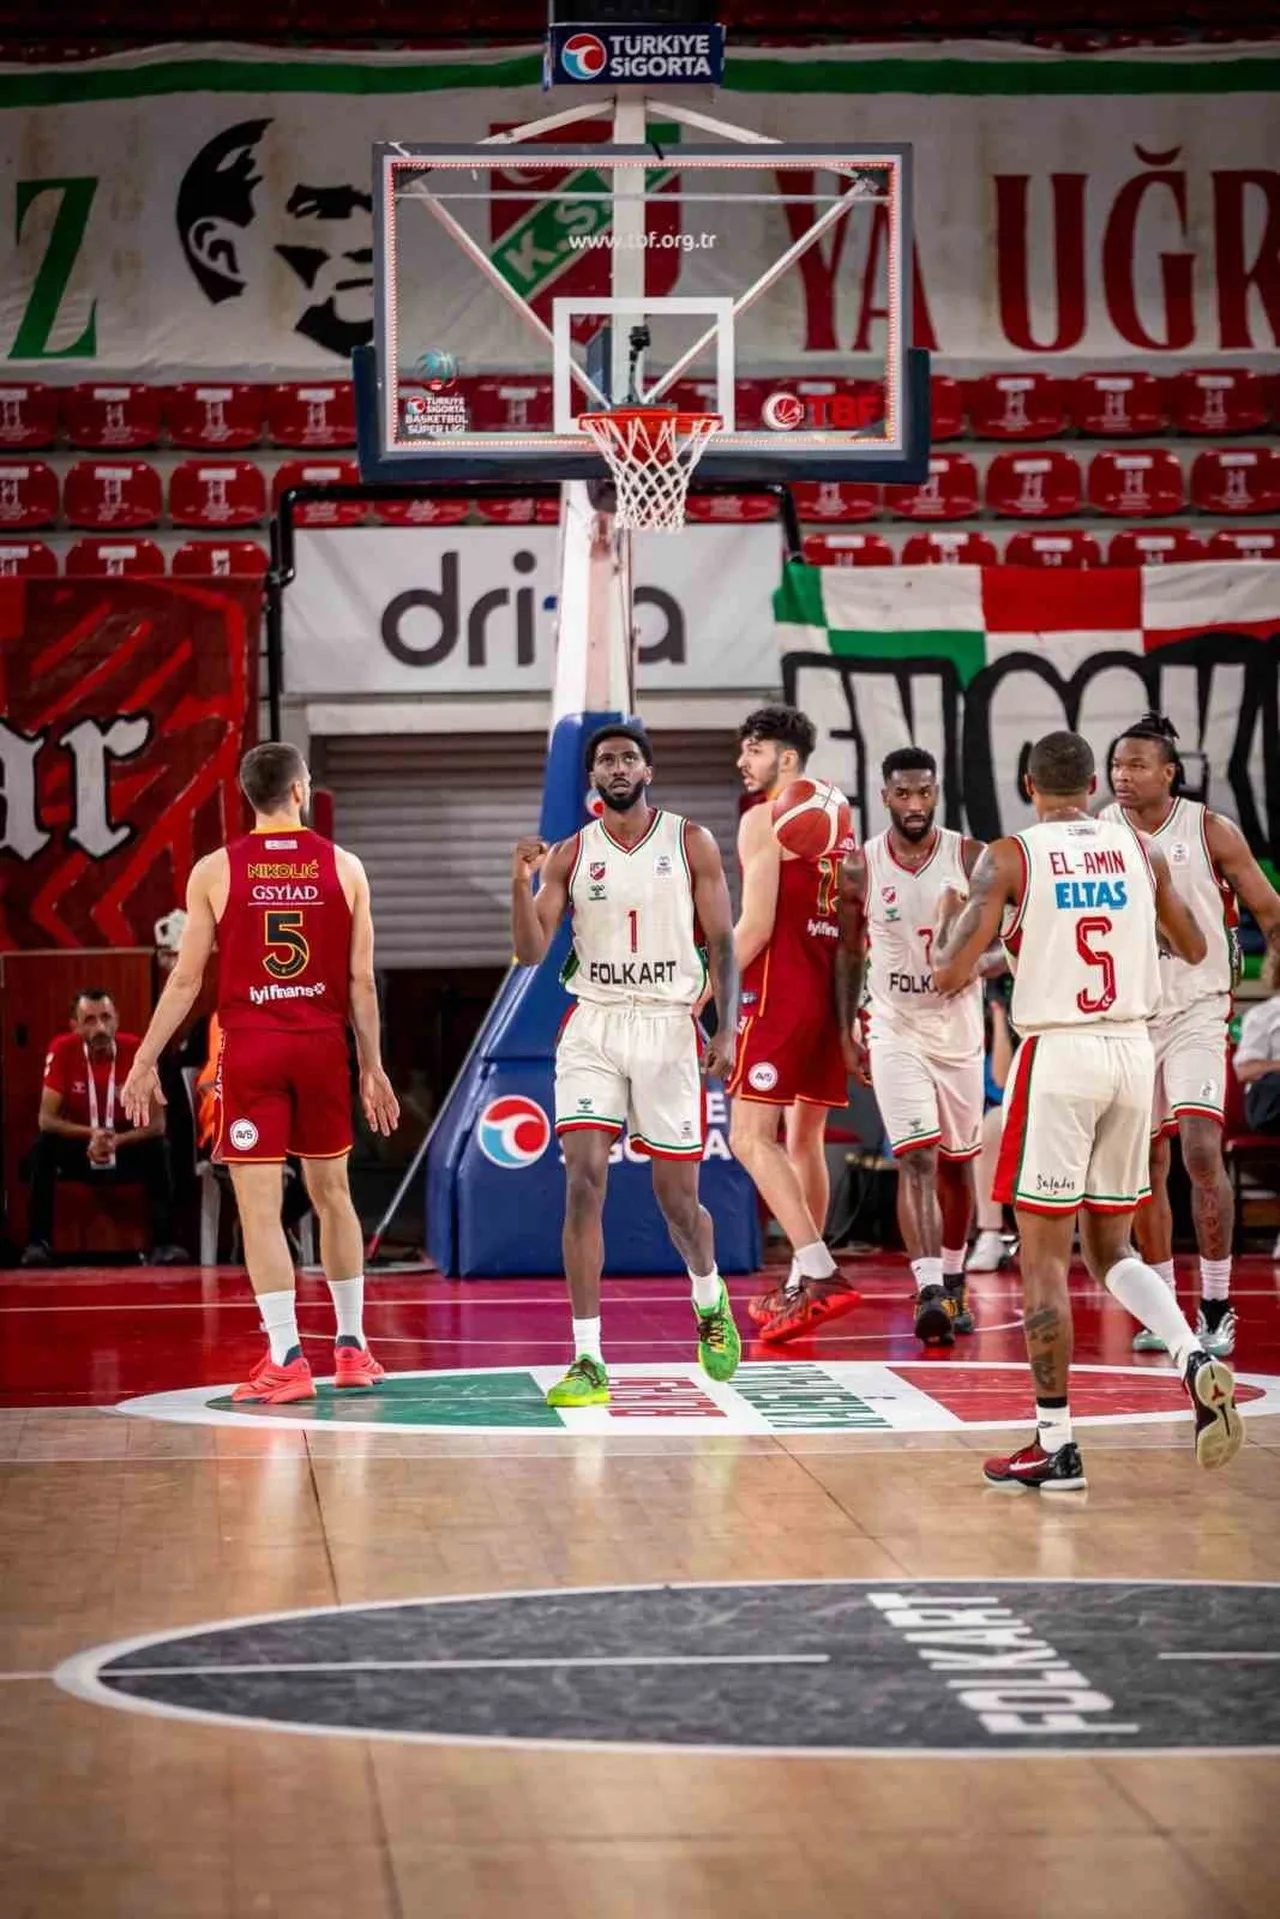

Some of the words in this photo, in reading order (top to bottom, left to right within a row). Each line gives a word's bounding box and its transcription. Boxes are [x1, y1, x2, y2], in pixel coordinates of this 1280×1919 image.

[609, 34, 710, 55] TÜRKİYE
[610, 56, 712, 77] SİGORTA
[7, 177, 98, 359] Z
[804, 394, 878, 427] TBF
[1049, 850, 1126, 875] EL-AMIN
[262, 911, 310, 980] 5
[628, 910, 638, 953] 1
[590, 961, 677, 985] FOLKART
[1076, 916, 1117, 1014] 5
[889, 972, 933, 994] FOLK
[866, 1592, 1141, 1734] FOLKART
